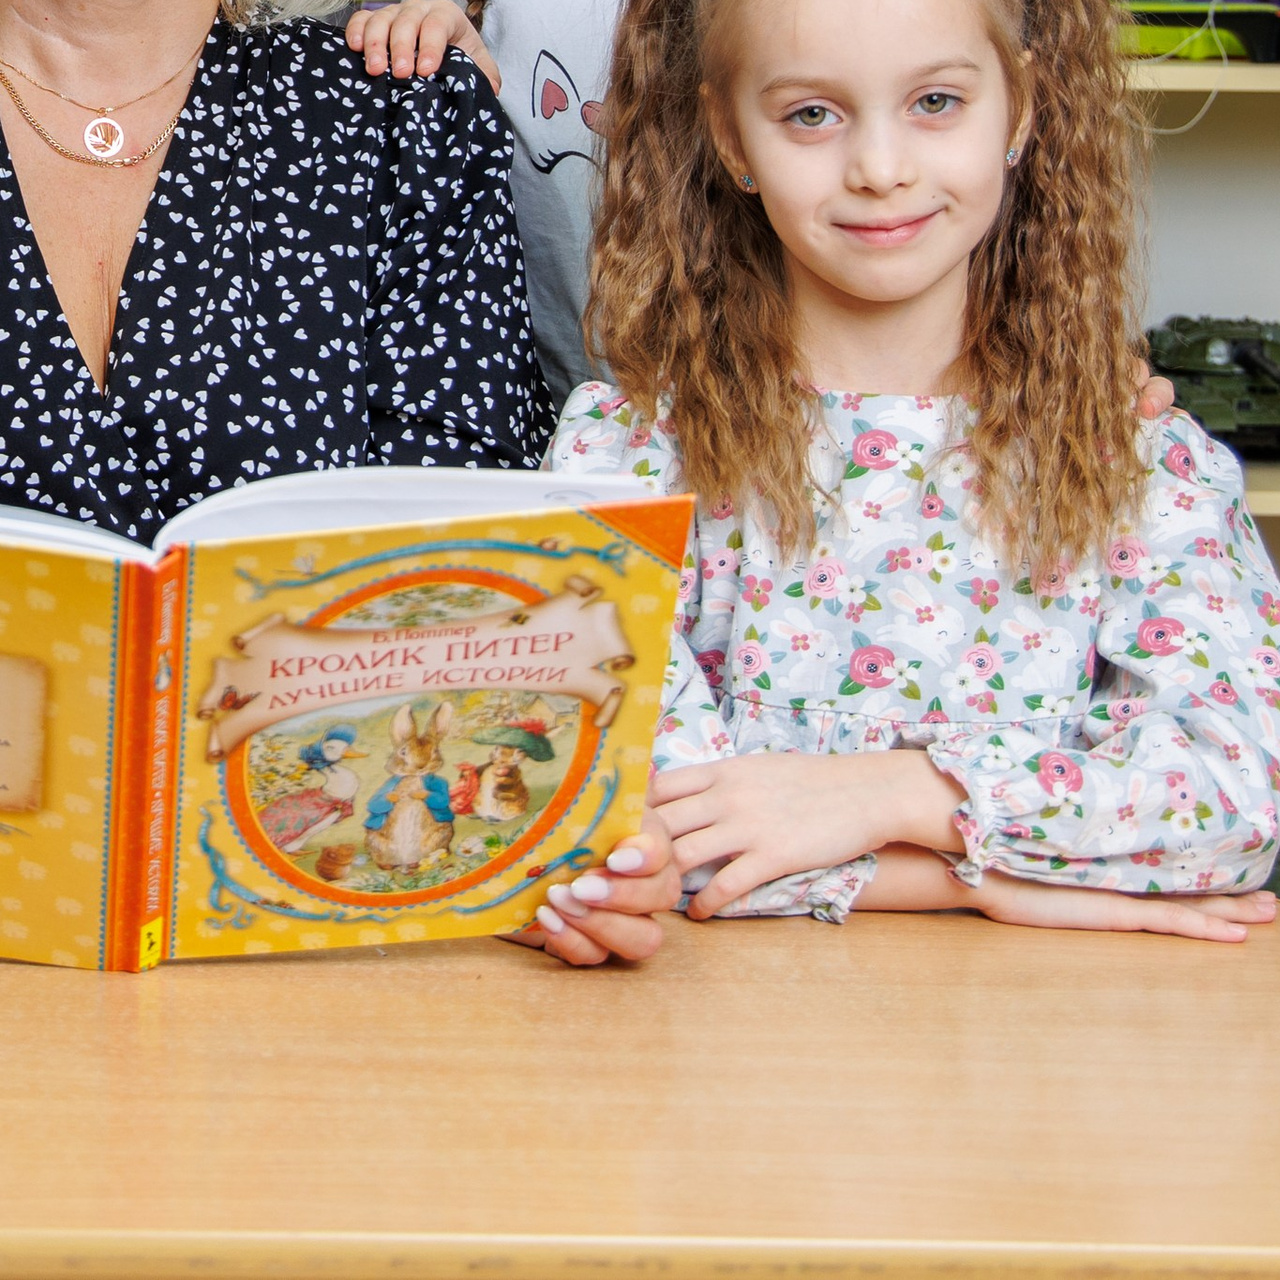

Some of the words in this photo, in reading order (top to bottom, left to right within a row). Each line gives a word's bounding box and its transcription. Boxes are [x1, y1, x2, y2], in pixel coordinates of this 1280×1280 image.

[269, 644, 425, 679] КРОЛИК
[445, 631, 575, 662] ПИТЕР
[268, 671, 404, 710] ЛУЧШИЕ
[422, 665, 572, 686] ИСТОРИИ
